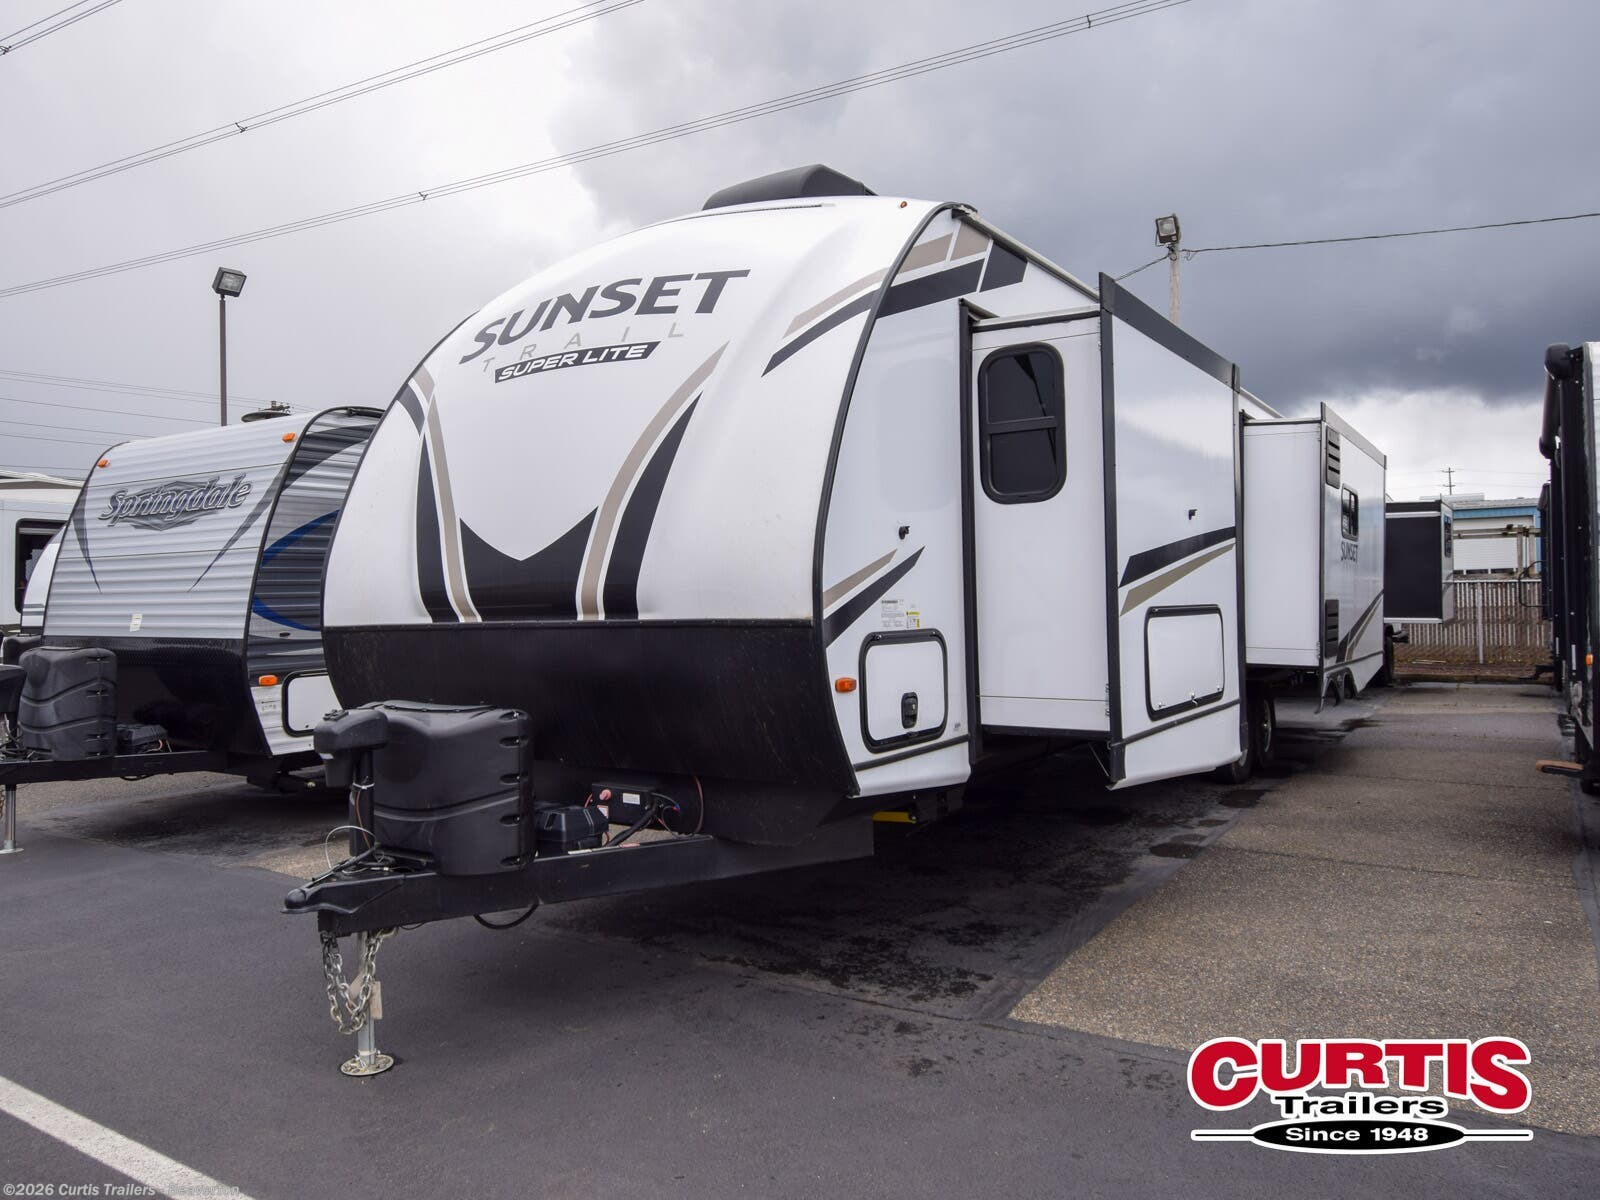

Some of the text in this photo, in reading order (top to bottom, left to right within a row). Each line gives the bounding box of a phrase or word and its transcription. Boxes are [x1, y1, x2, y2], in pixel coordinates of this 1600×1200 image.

[459, 269, 751, 365] SUNSET
[482, 322, 685, 373] TRAIL
[498, 344, 649, 381] SUPER LITE
[98, 472, 252, 526] Springdale
[1340, 541, 1358, 563] SUNSET
